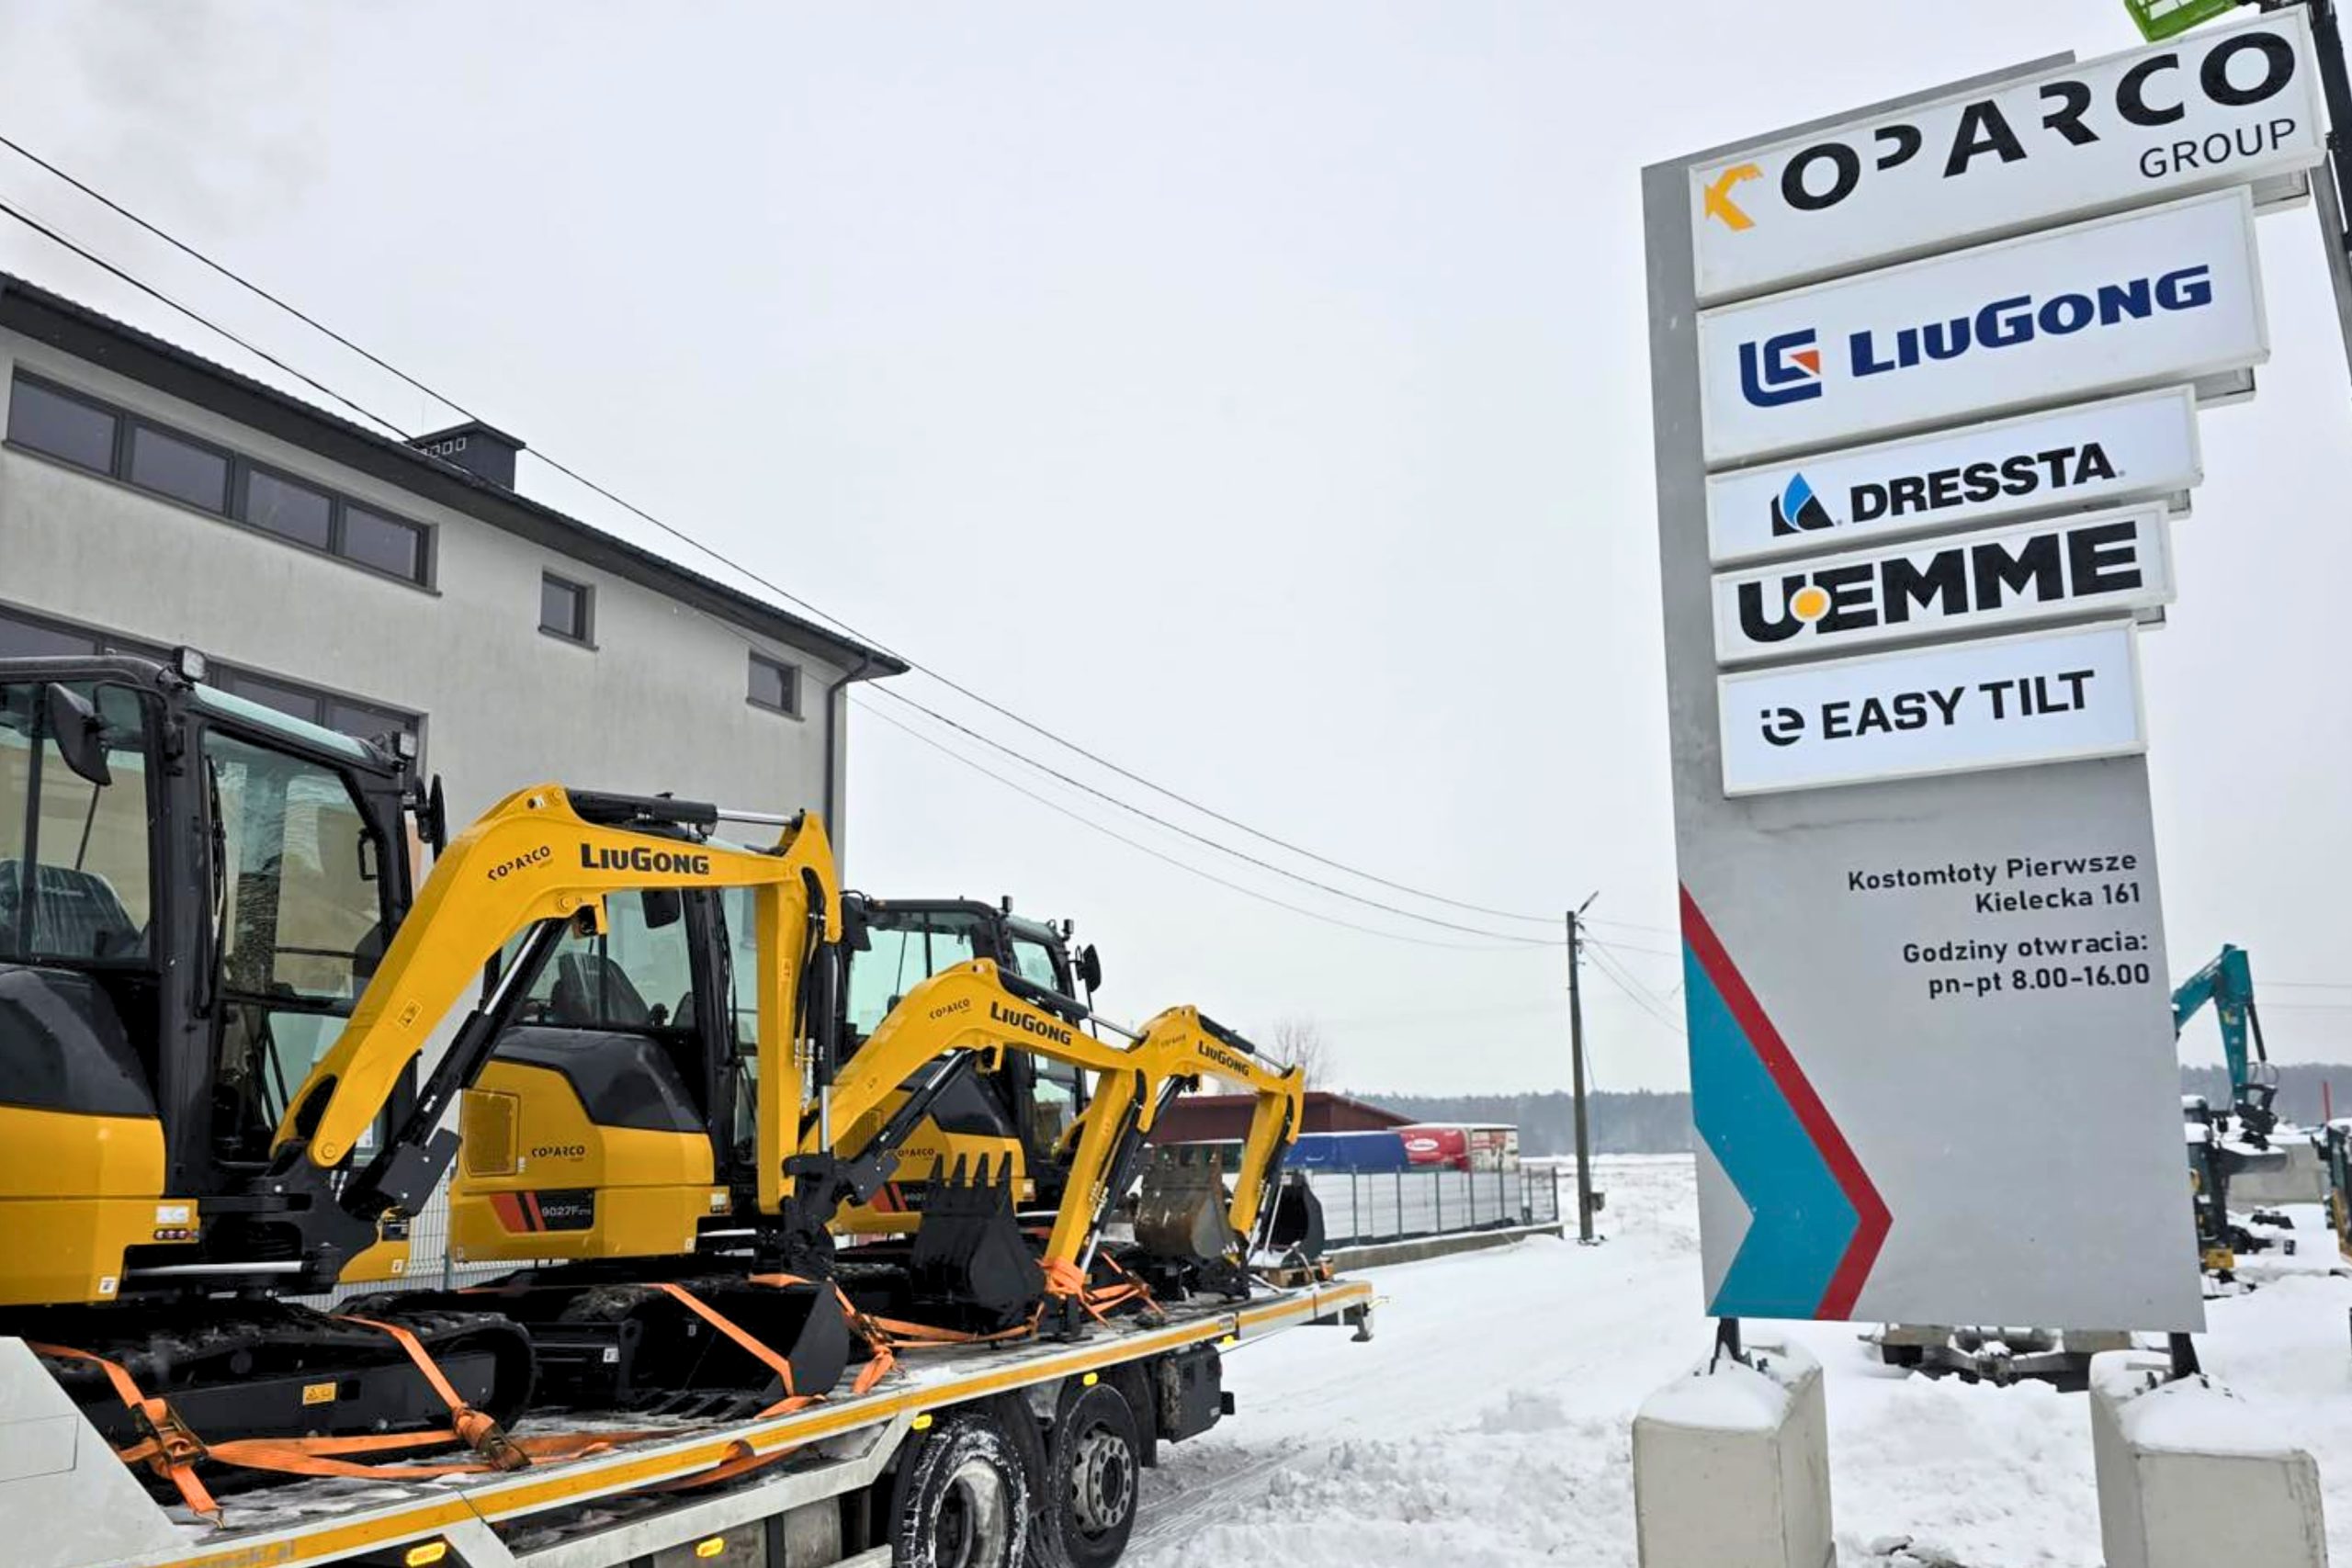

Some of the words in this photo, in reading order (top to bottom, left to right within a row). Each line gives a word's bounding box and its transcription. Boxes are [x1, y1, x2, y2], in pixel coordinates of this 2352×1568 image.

[2139, 118, 2296, 178] GROUP
[1850, 442, 2117, 524] DRESSTA
[1738, 520, 2143, 643] UEMME
[1822, 686, 1965, 740] EASY
[1978, 670, 2095, 720] TILT
[1848, 863, 1997, 892] Kostomłoty
[2007, 853, 2138, 879] Pierwsze
[1975, 881, 2094, 914] Kielecka
[2101, 882, 2141, 906] 161
[1903, 939, 2008, 964] Godziny
[2018, 931, 2149, 957] otwracia:
[1928, 972, 2003, 1000] pn-pt
[2011, 963, 2151, 990] 8.00-16.00
